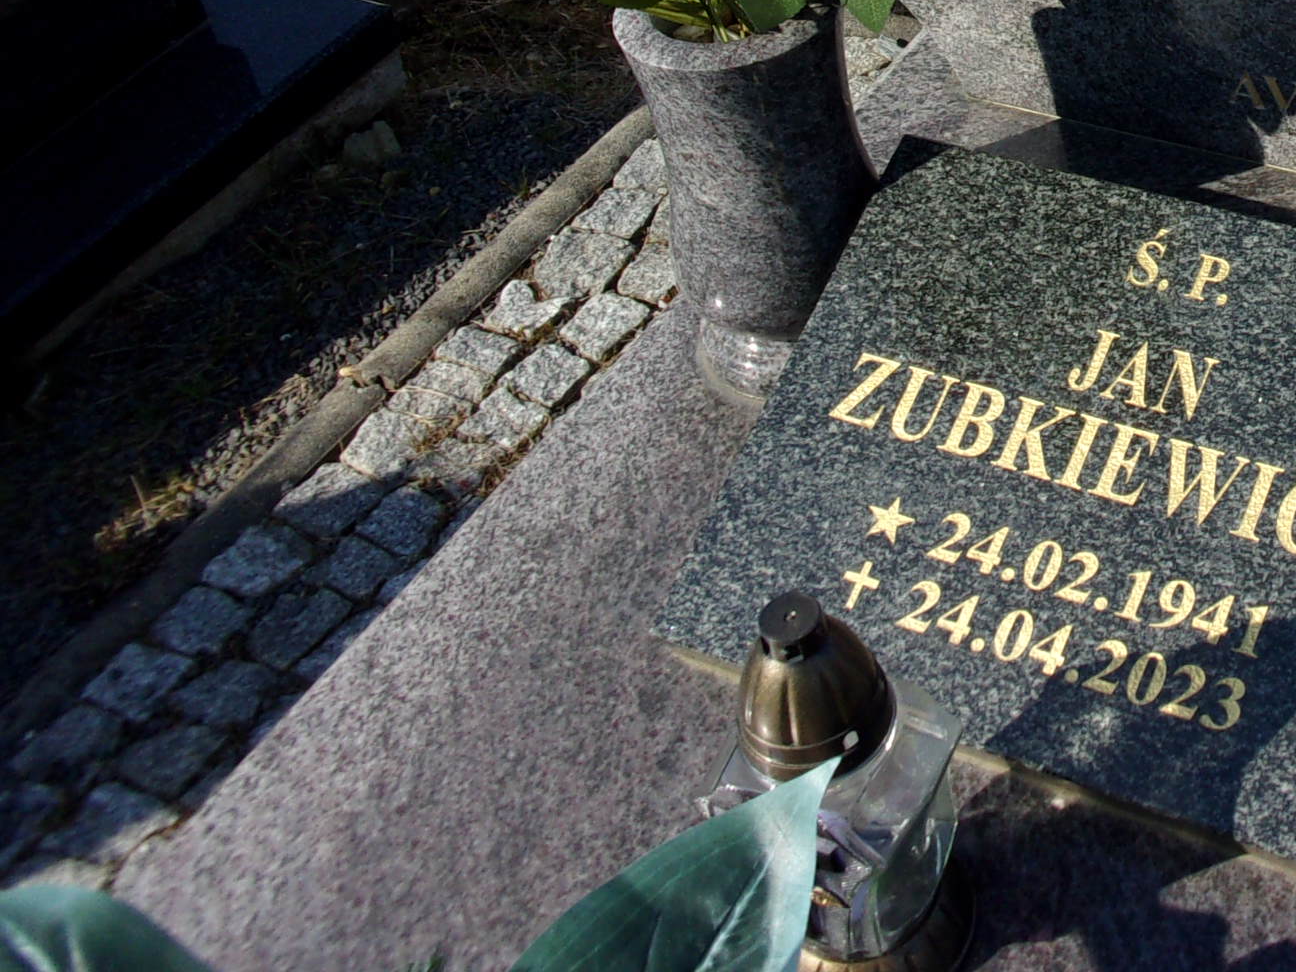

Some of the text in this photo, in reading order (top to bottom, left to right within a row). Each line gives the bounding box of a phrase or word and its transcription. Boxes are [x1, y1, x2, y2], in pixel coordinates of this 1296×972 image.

[1125, 229, 1231, 306] Ś. P.
[1067, 329, 1221, 421] JAN
[925, 512, 1271, 659] 24.02.1941
[896, 580, 1247, 731] 24.04.2023
